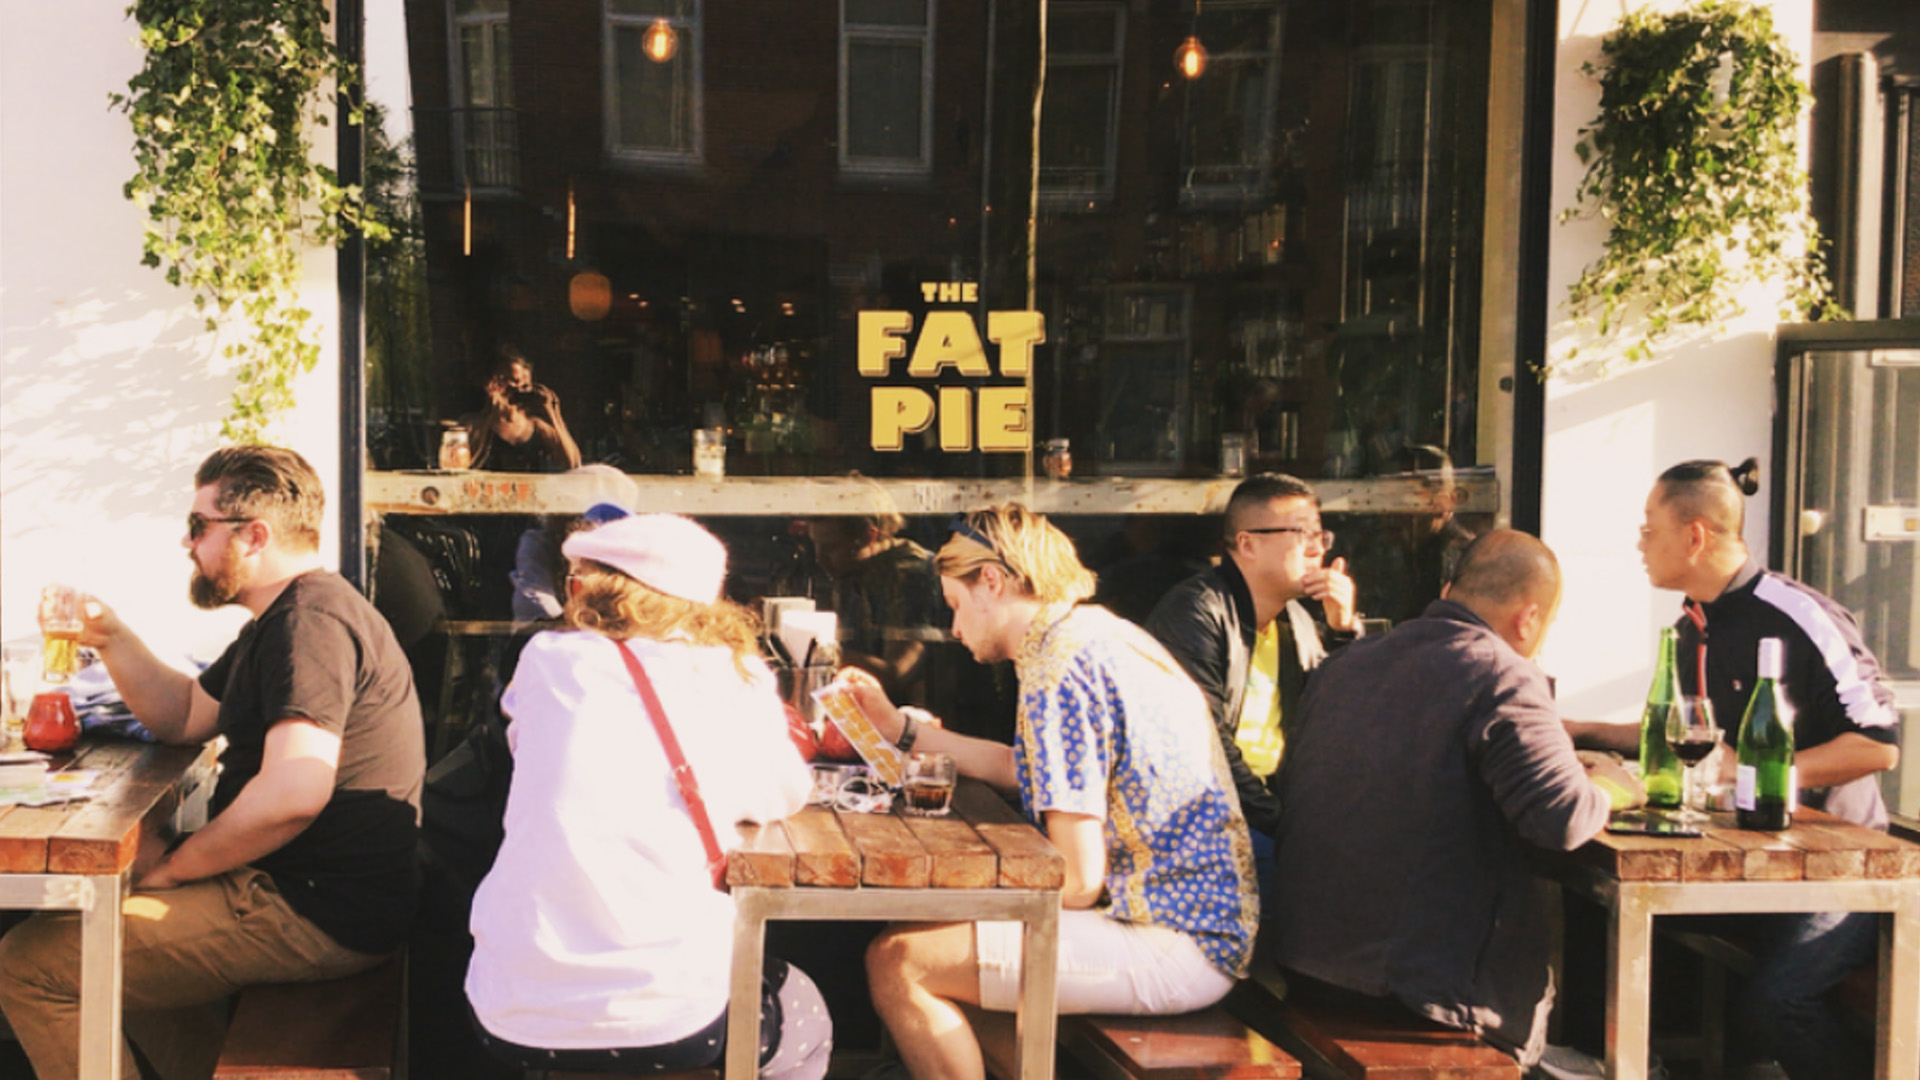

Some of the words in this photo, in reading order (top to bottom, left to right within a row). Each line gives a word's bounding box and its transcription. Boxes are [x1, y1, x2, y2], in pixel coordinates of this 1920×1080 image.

[921, 282, 978, 302] THE
[858, 310, 1045, 377] FAT
[871, 386, 1033, 451] PIE
